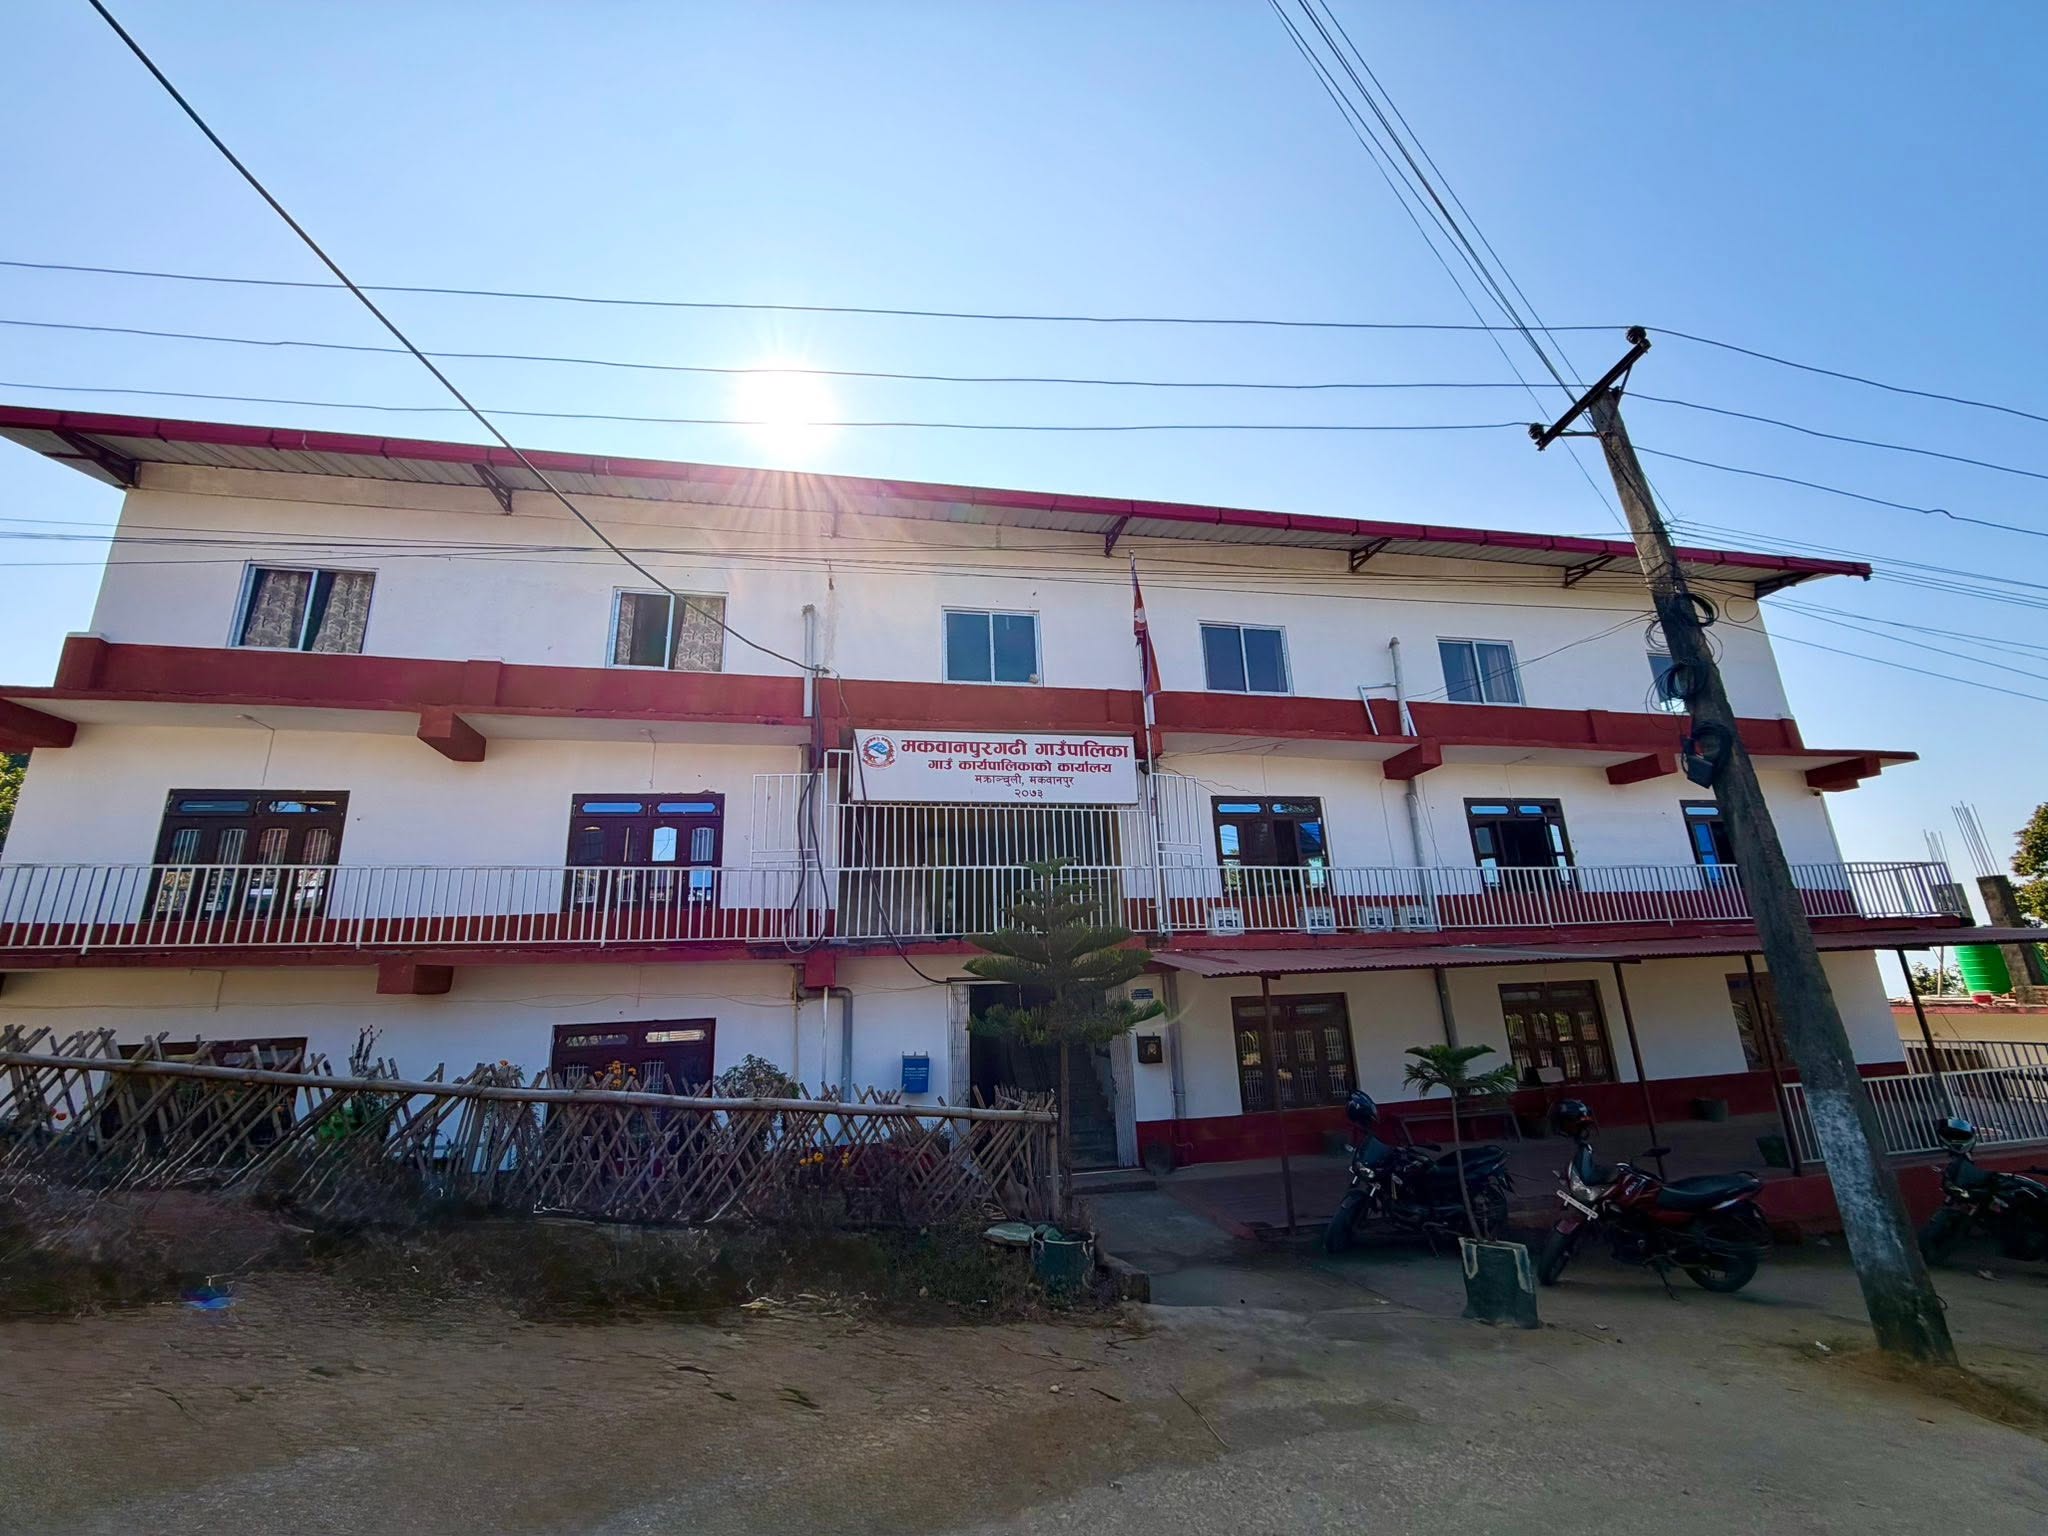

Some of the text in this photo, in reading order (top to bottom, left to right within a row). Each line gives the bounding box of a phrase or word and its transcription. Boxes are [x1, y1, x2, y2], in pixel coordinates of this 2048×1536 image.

[901, 739, 1129, 758] मकवानपुरगढी गाउँपालिका
[928, 757, 1112, 773] गाउँ कार्यपालिकाको कार्यालय
[1029, 775, 1075, 788] मकवानपुर
[1014, 788, 1044, 799] २०७३
